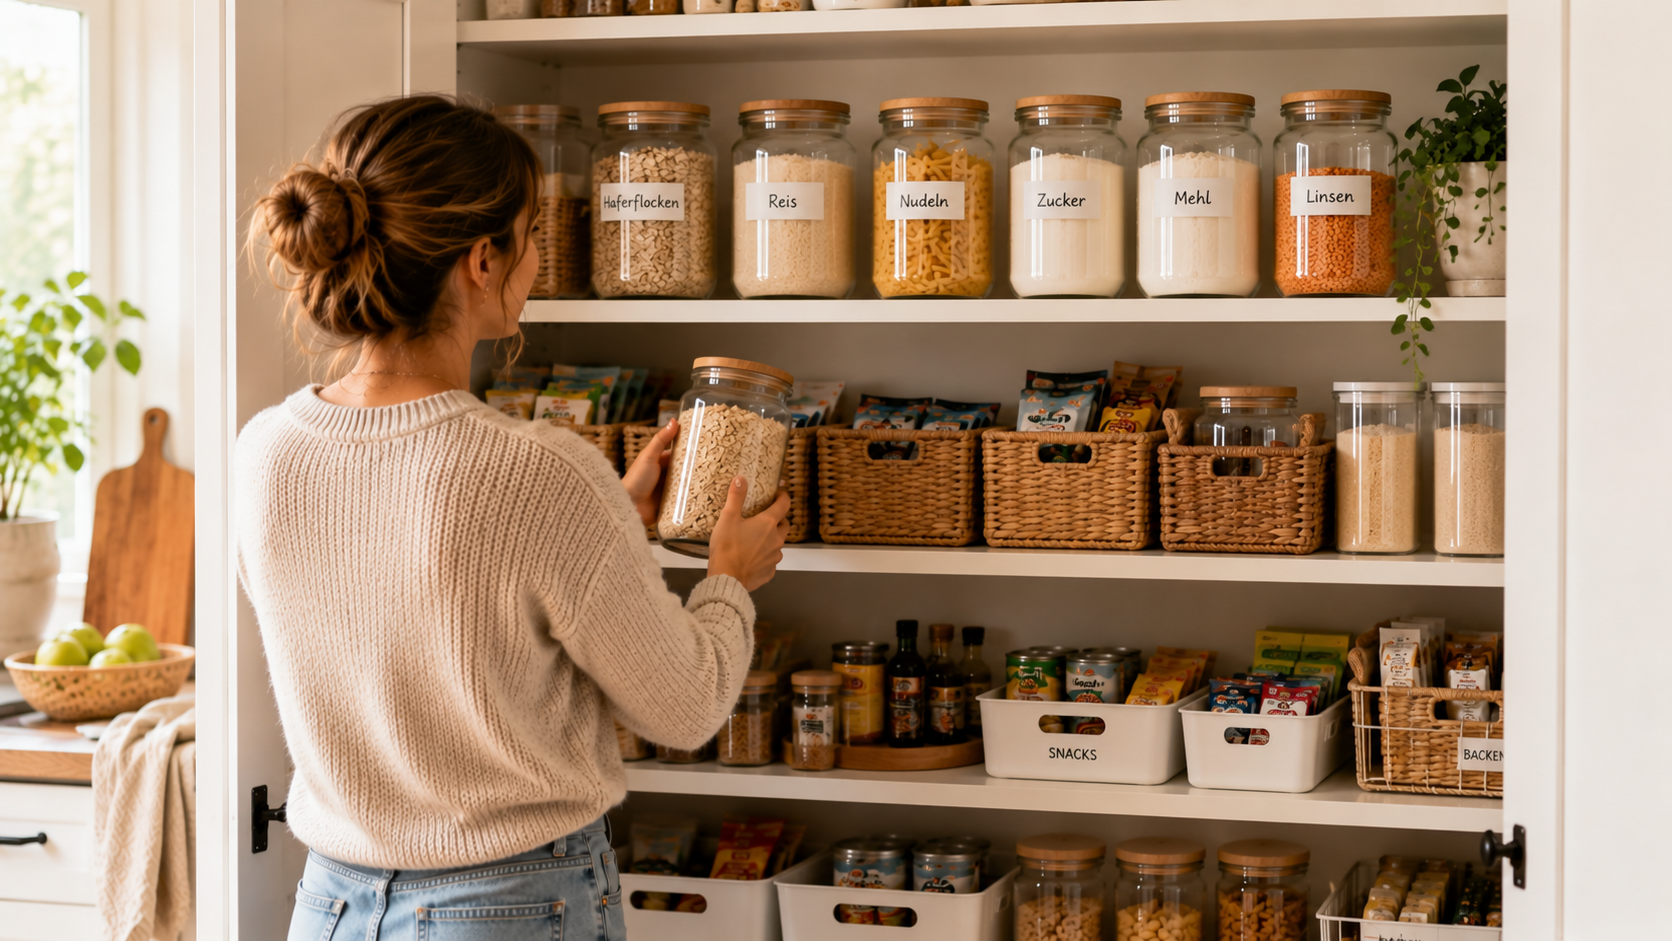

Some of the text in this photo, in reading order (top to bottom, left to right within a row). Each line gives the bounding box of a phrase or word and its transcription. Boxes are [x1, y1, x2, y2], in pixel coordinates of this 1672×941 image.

[603, 194, 680, 212] Haferflocken
[768, 194, 798, 209] Reis
[899, 193, 950, 208] Nudeln
[1036, 192, 1086, 208] Zucker
[1174, 189, 1212, 205] Mehl
[1306, 189, 1355, 203] Linsen
[1048, 746, 1098, 761] SNACKS
